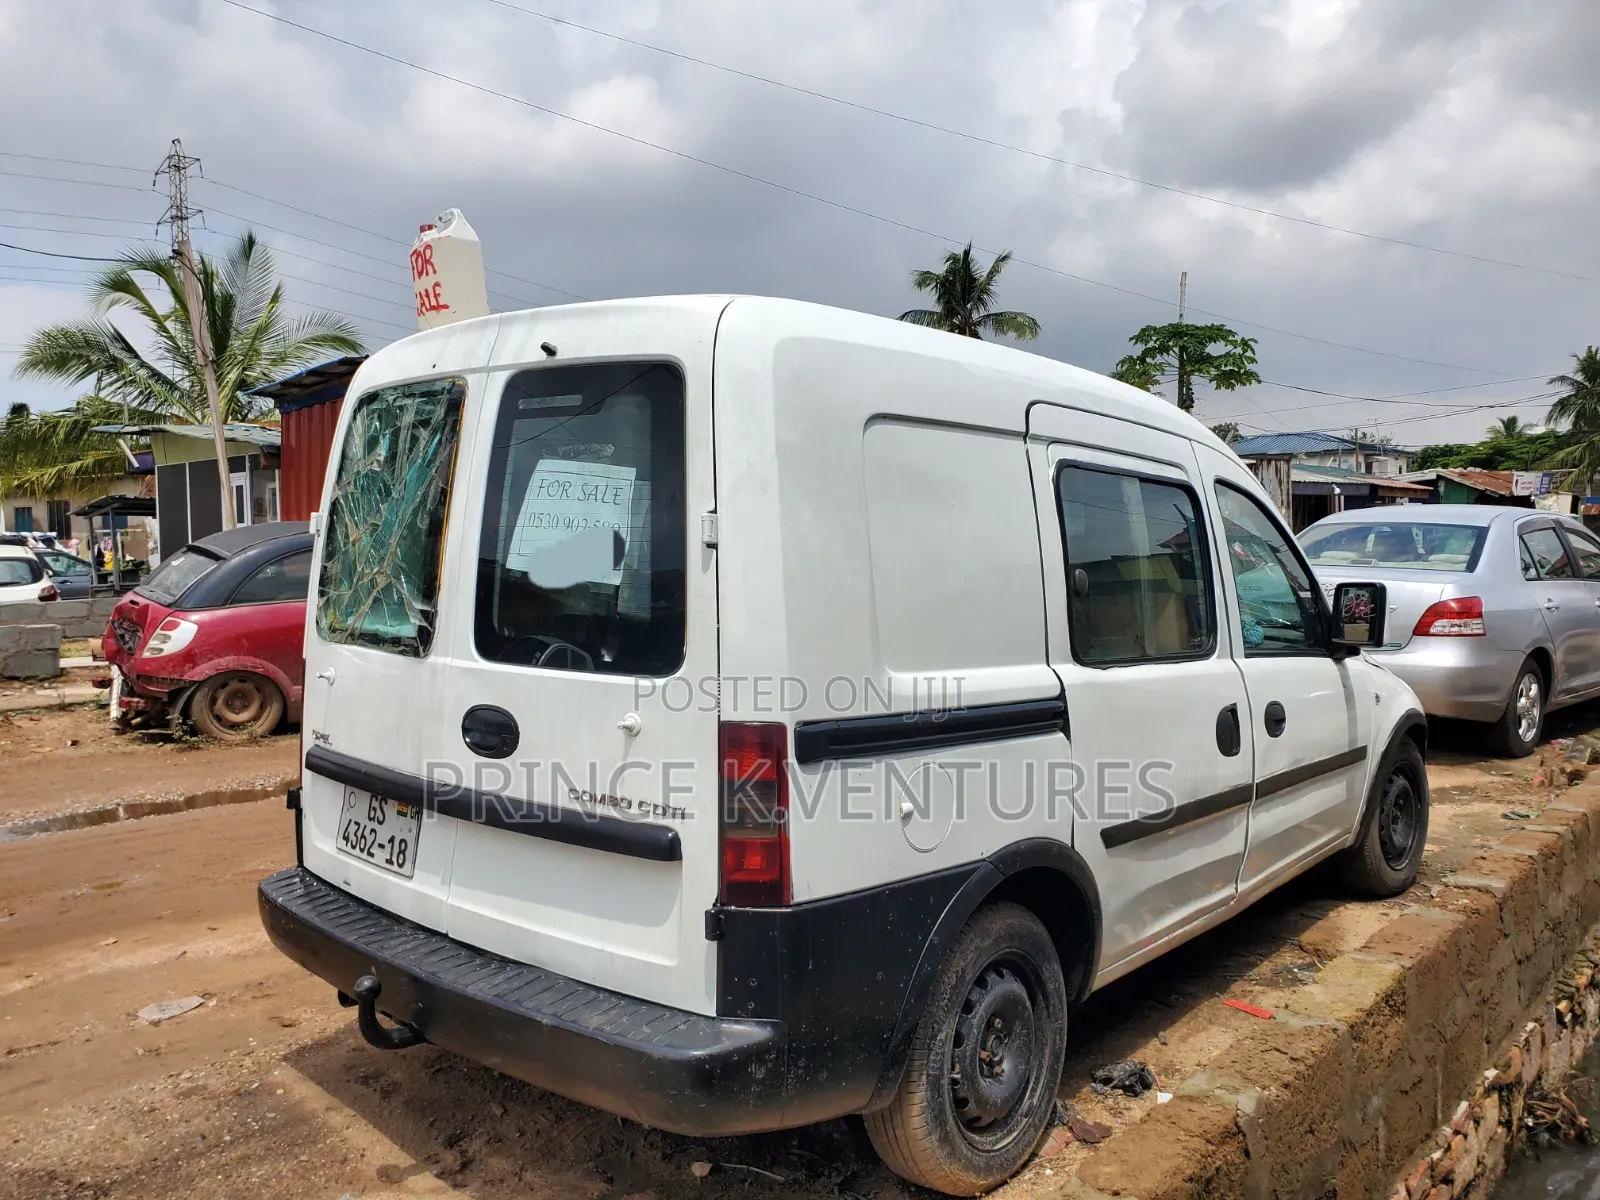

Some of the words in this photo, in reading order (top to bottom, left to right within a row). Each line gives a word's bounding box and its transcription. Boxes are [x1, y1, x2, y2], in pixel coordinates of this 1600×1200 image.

[537, 478, 572, 500] FOR
[577, 482, 624, 506] SALE
[368, 793, 388, 826] GS
[568, 788, 633, 810] COMBO
[342, 818, 409, 869] 4362-18
